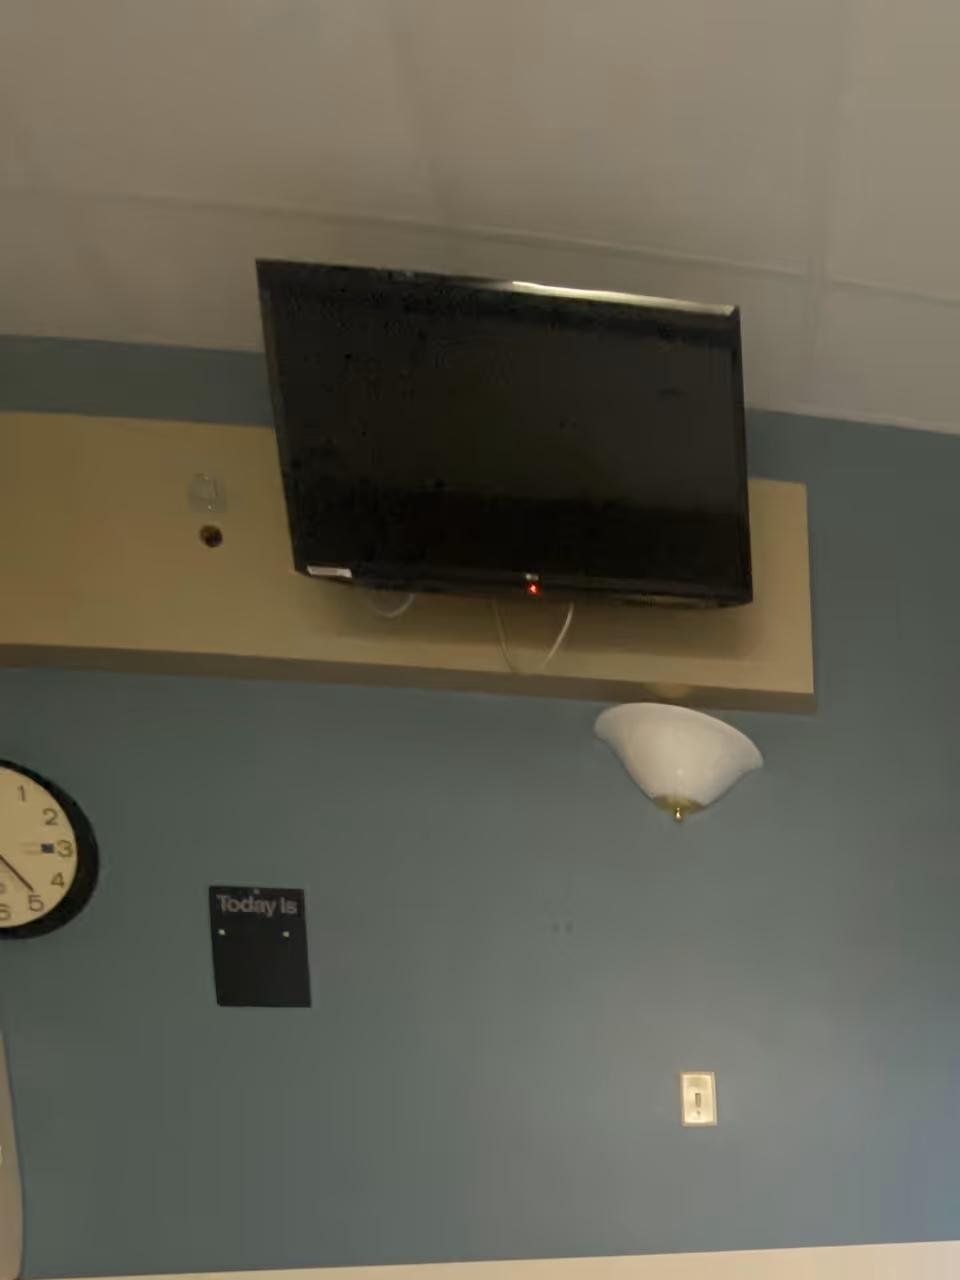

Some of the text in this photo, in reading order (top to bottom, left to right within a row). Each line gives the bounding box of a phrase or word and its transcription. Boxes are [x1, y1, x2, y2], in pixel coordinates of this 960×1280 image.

[17, 784, 26, 802] 1
[42, 807, 59, 826] 2
[57, 839, 73, 858] 3
[50, 872, 65, 888] 4
[28, 894, 45, 913] 5
[216, 894, 276, 918] Today
